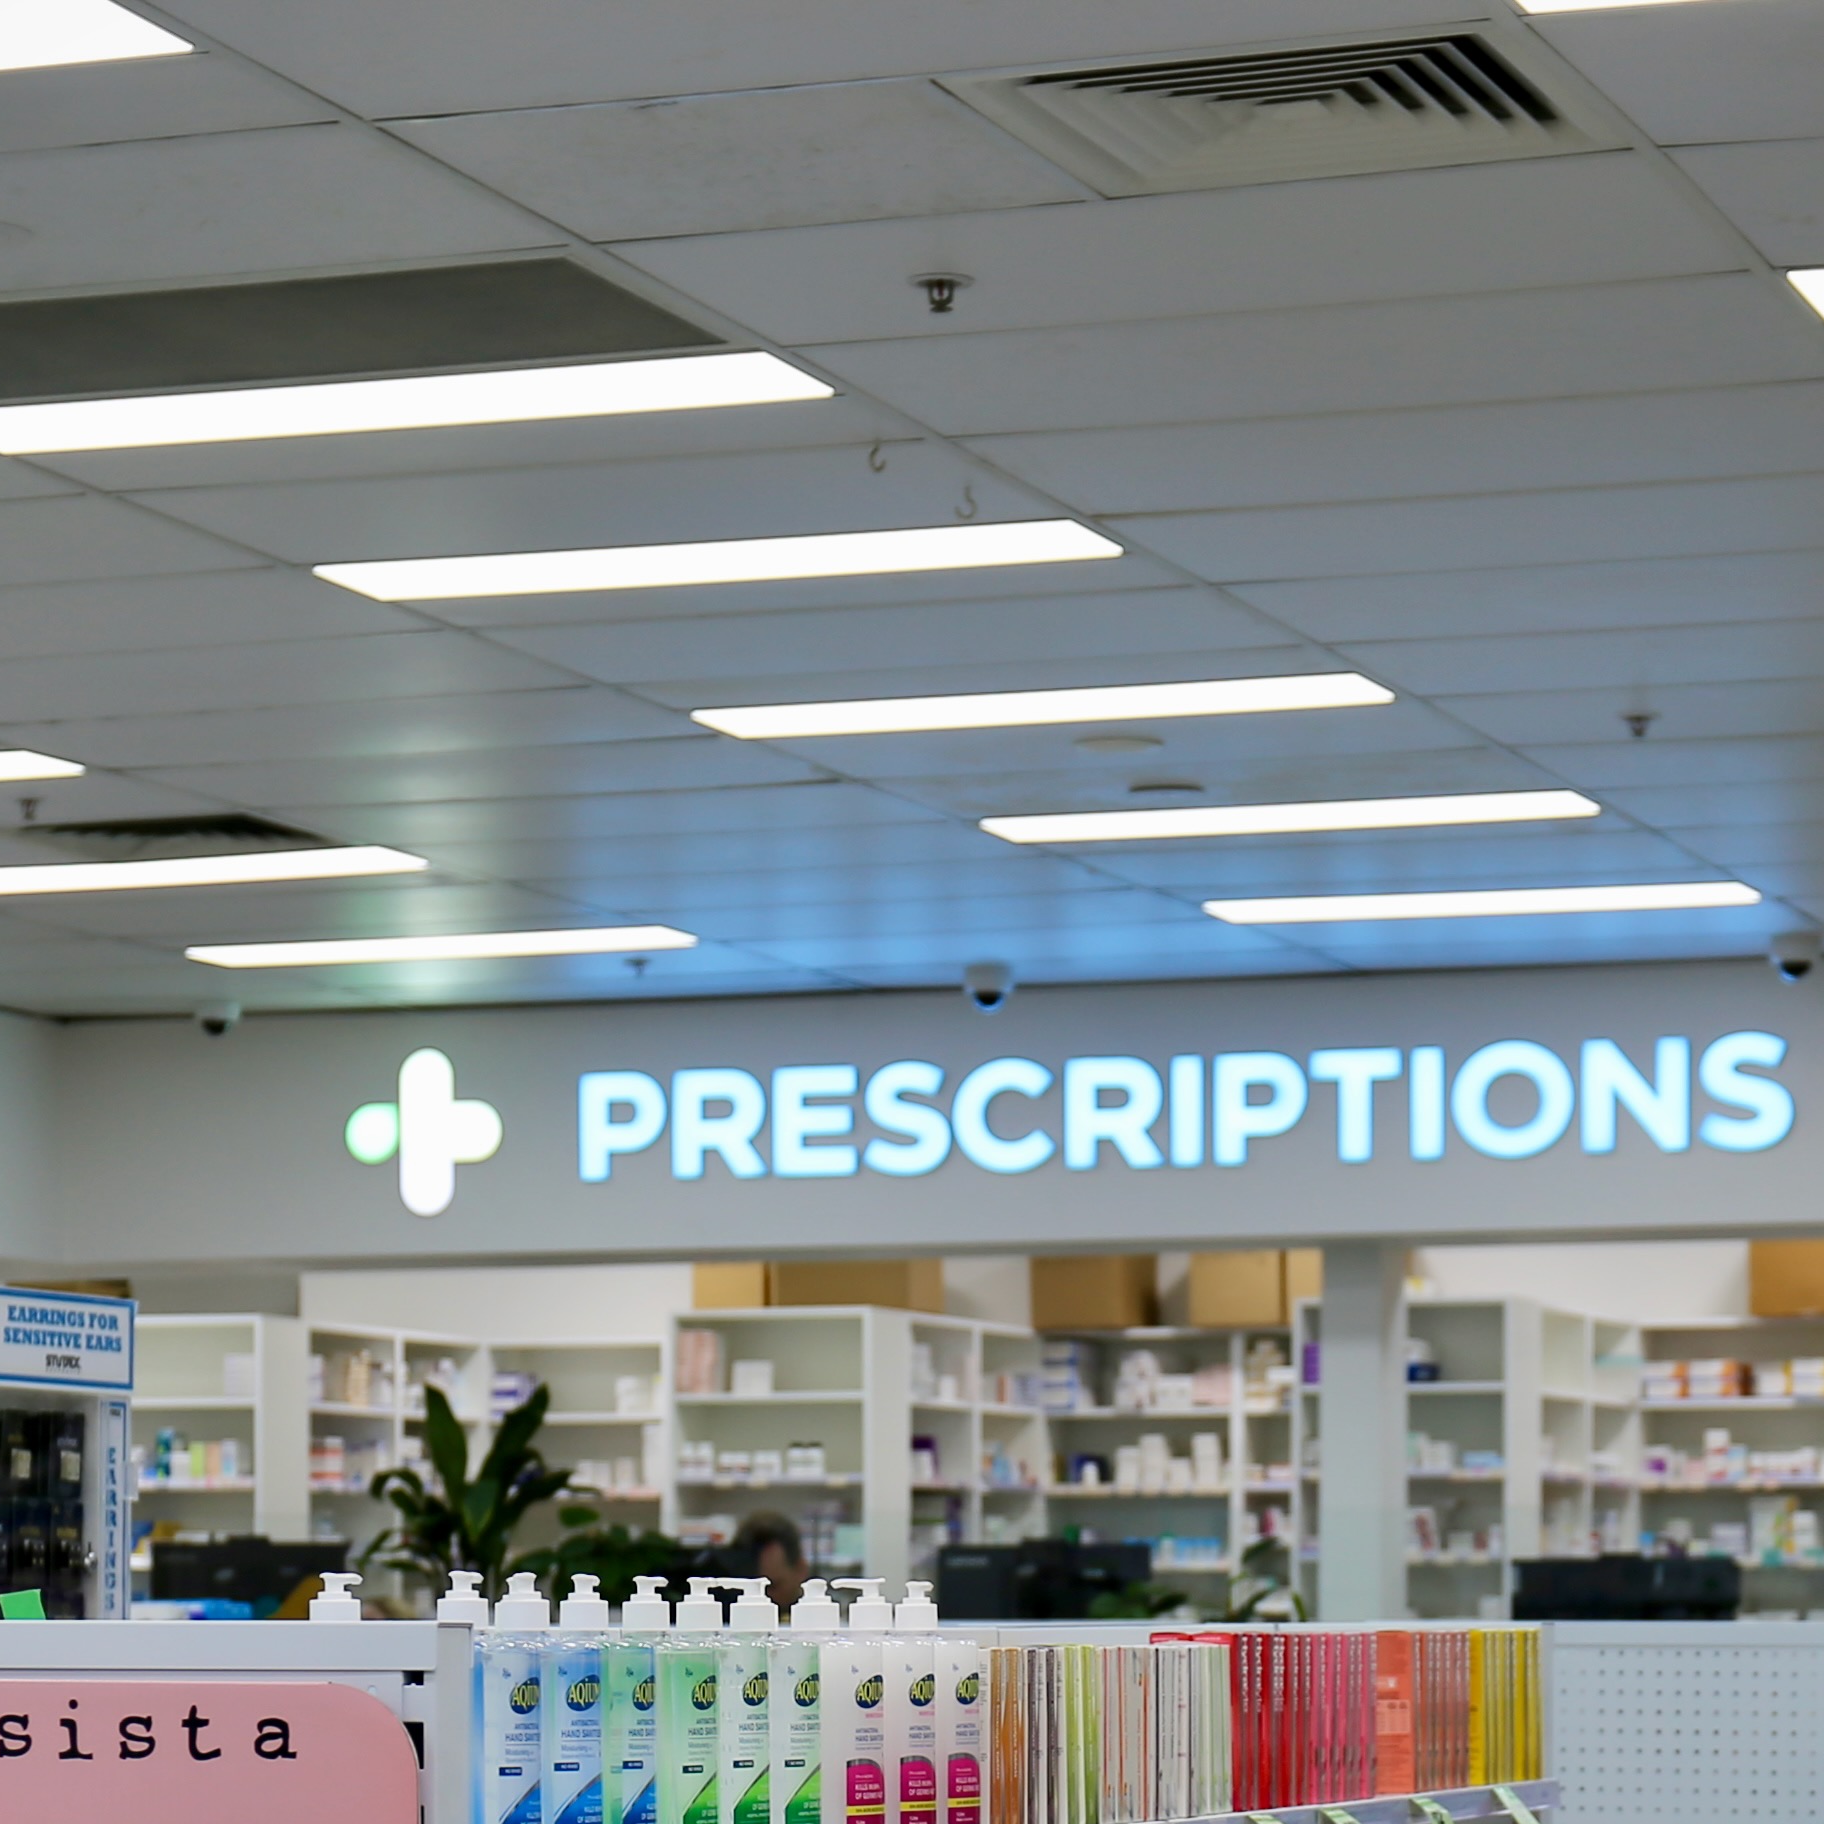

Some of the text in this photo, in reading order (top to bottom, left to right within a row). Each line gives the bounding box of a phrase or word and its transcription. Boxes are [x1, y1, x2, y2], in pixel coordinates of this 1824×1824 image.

[576, 1030, 1797, 1184] PRESCRIPTIONS
[8, 1304, 119, 1330] EARRINGS FOR
[3, 1327, 122, 1353] SENSITIVE EARS
